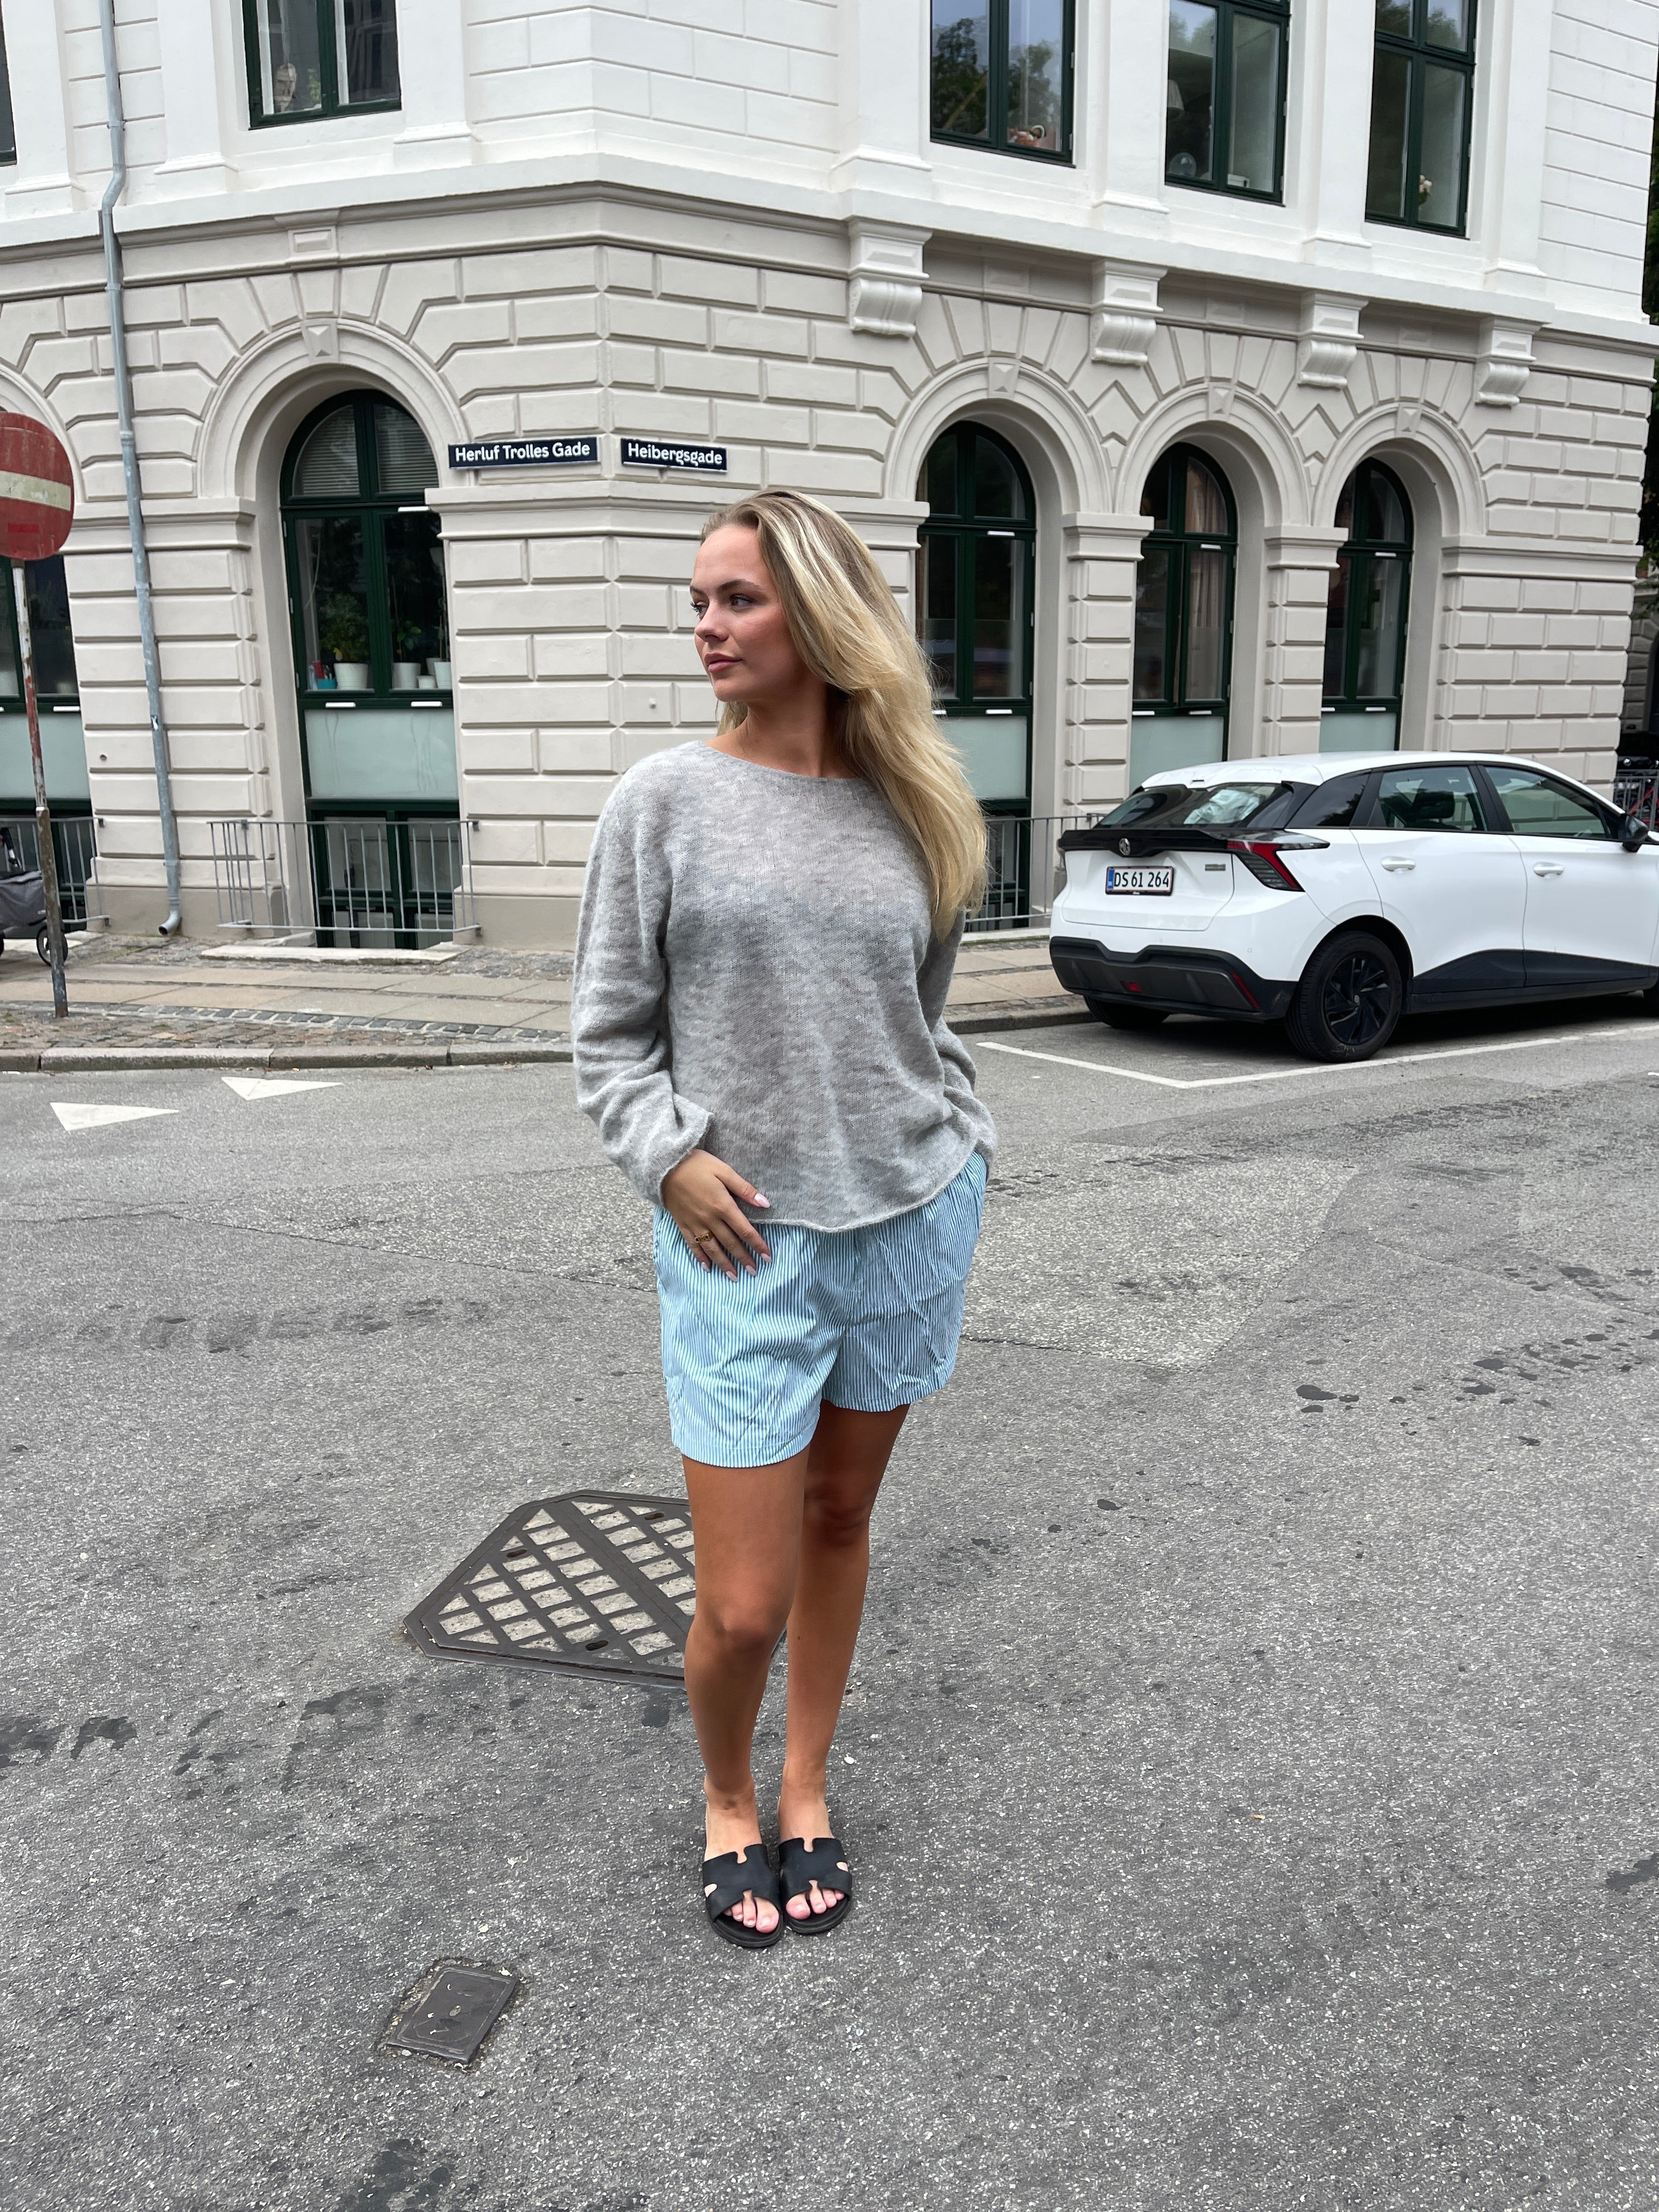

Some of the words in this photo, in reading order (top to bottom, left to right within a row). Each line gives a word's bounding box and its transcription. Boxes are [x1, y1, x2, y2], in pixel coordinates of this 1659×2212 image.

[455, 445, 499, 461] Herluf
[503, 443, 549, 459] Trolles
[552, 441, 590, 457] Gade
[628, 443, 723, 466] Heibergsgade
[1114, 872, 1128, 888] DS
[1131, 871, 1143, 888] 61
[1148, 871, 1170, 888] 264
